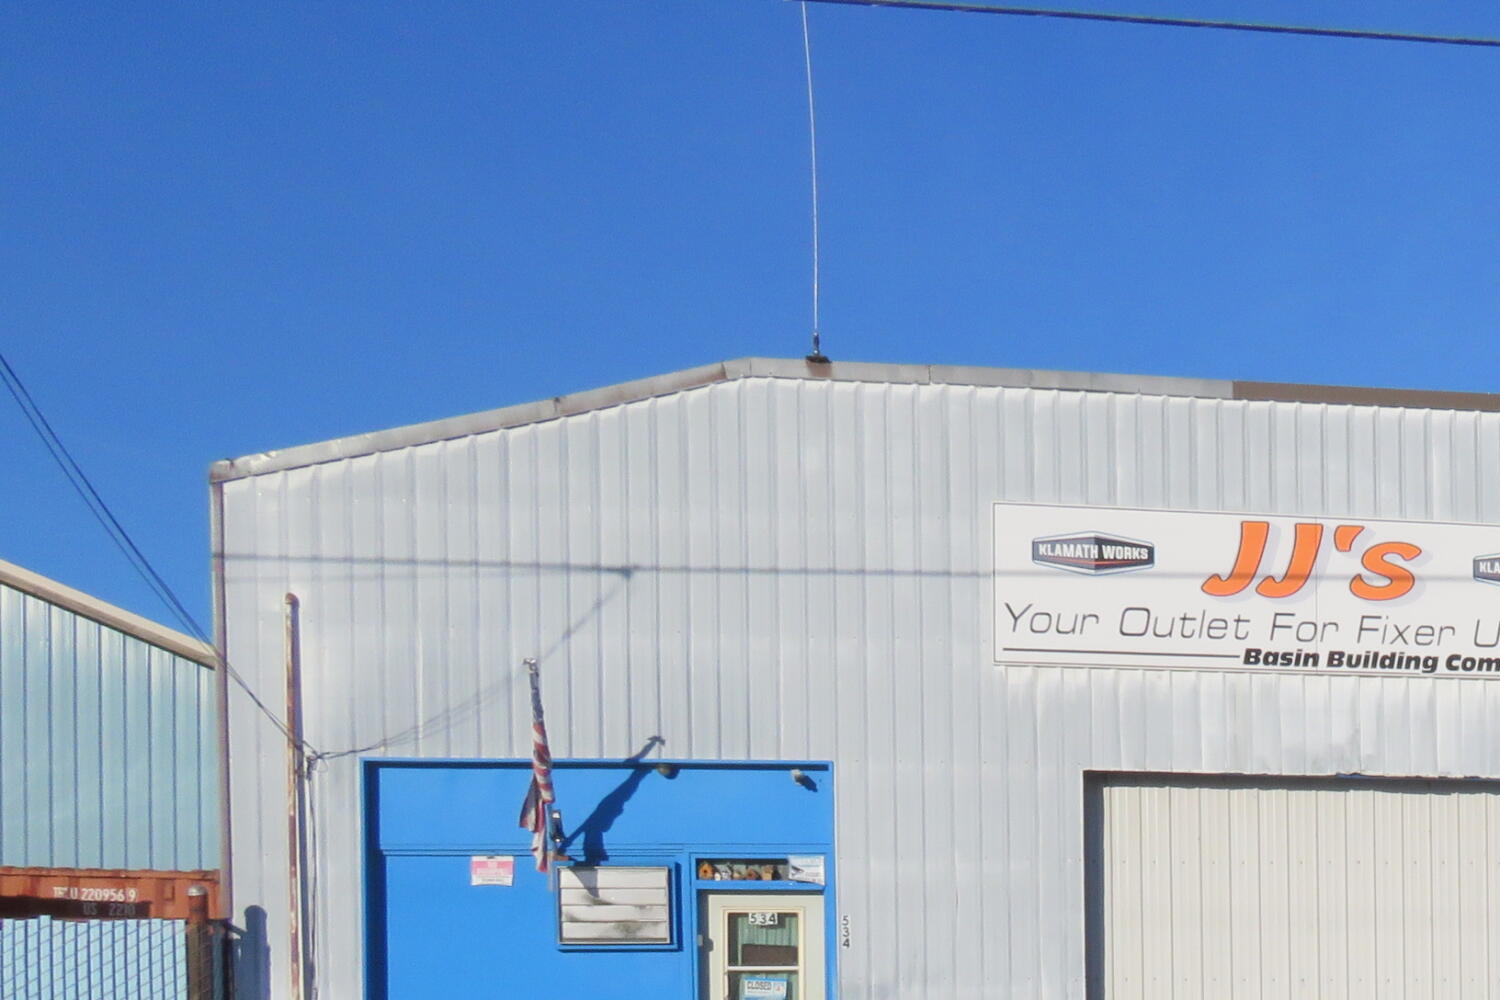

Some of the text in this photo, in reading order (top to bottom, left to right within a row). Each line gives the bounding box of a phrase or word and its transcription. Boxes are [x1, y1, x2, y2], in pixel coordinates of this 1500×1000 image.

[1038, 543, 1148, 560] KLAMATH WORKS
[1201, 520, 1422, 601] JJ's
[1004, 602, 1099, 635] Your
[1119, 606, 1251, 641] Outlet
[1269, 612, 1339, 643] For
[1356, 614, 1455, 647] Fixer
[1242, 648, 1319, 668] Basin
[1326, 650, 1439, 674] Building
[749, 913, 777, 925] 534
[842, 914, 850, 949] 534
